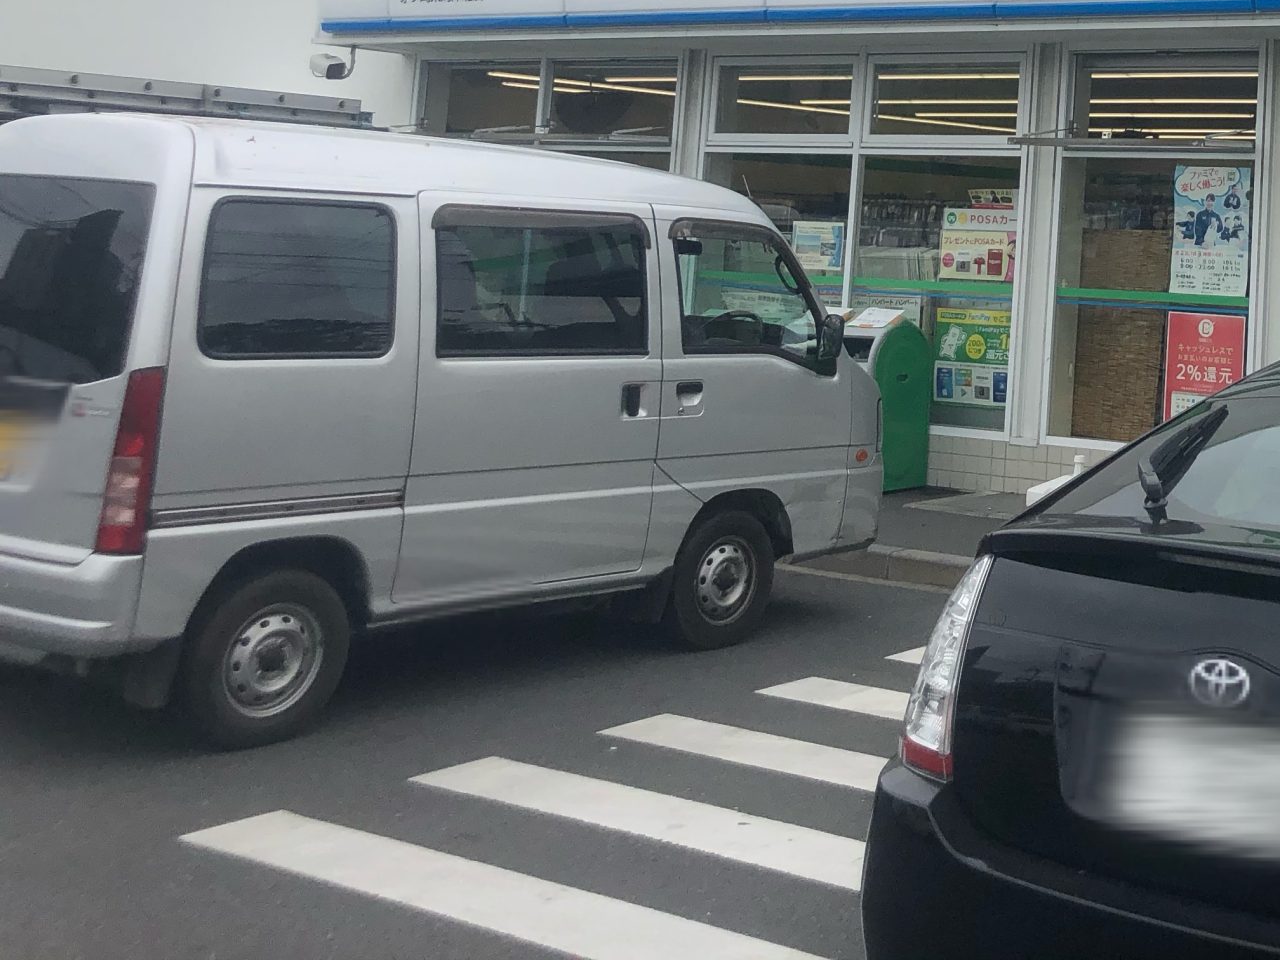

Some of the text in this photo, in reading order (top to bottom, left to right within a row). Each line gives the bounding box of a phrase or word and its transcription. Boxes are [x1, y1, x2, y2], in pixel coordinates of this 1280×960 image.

[1178, 344, 1234, 356] キャッシュレスで
[1176, 363, 1233, 384] 2%還元
